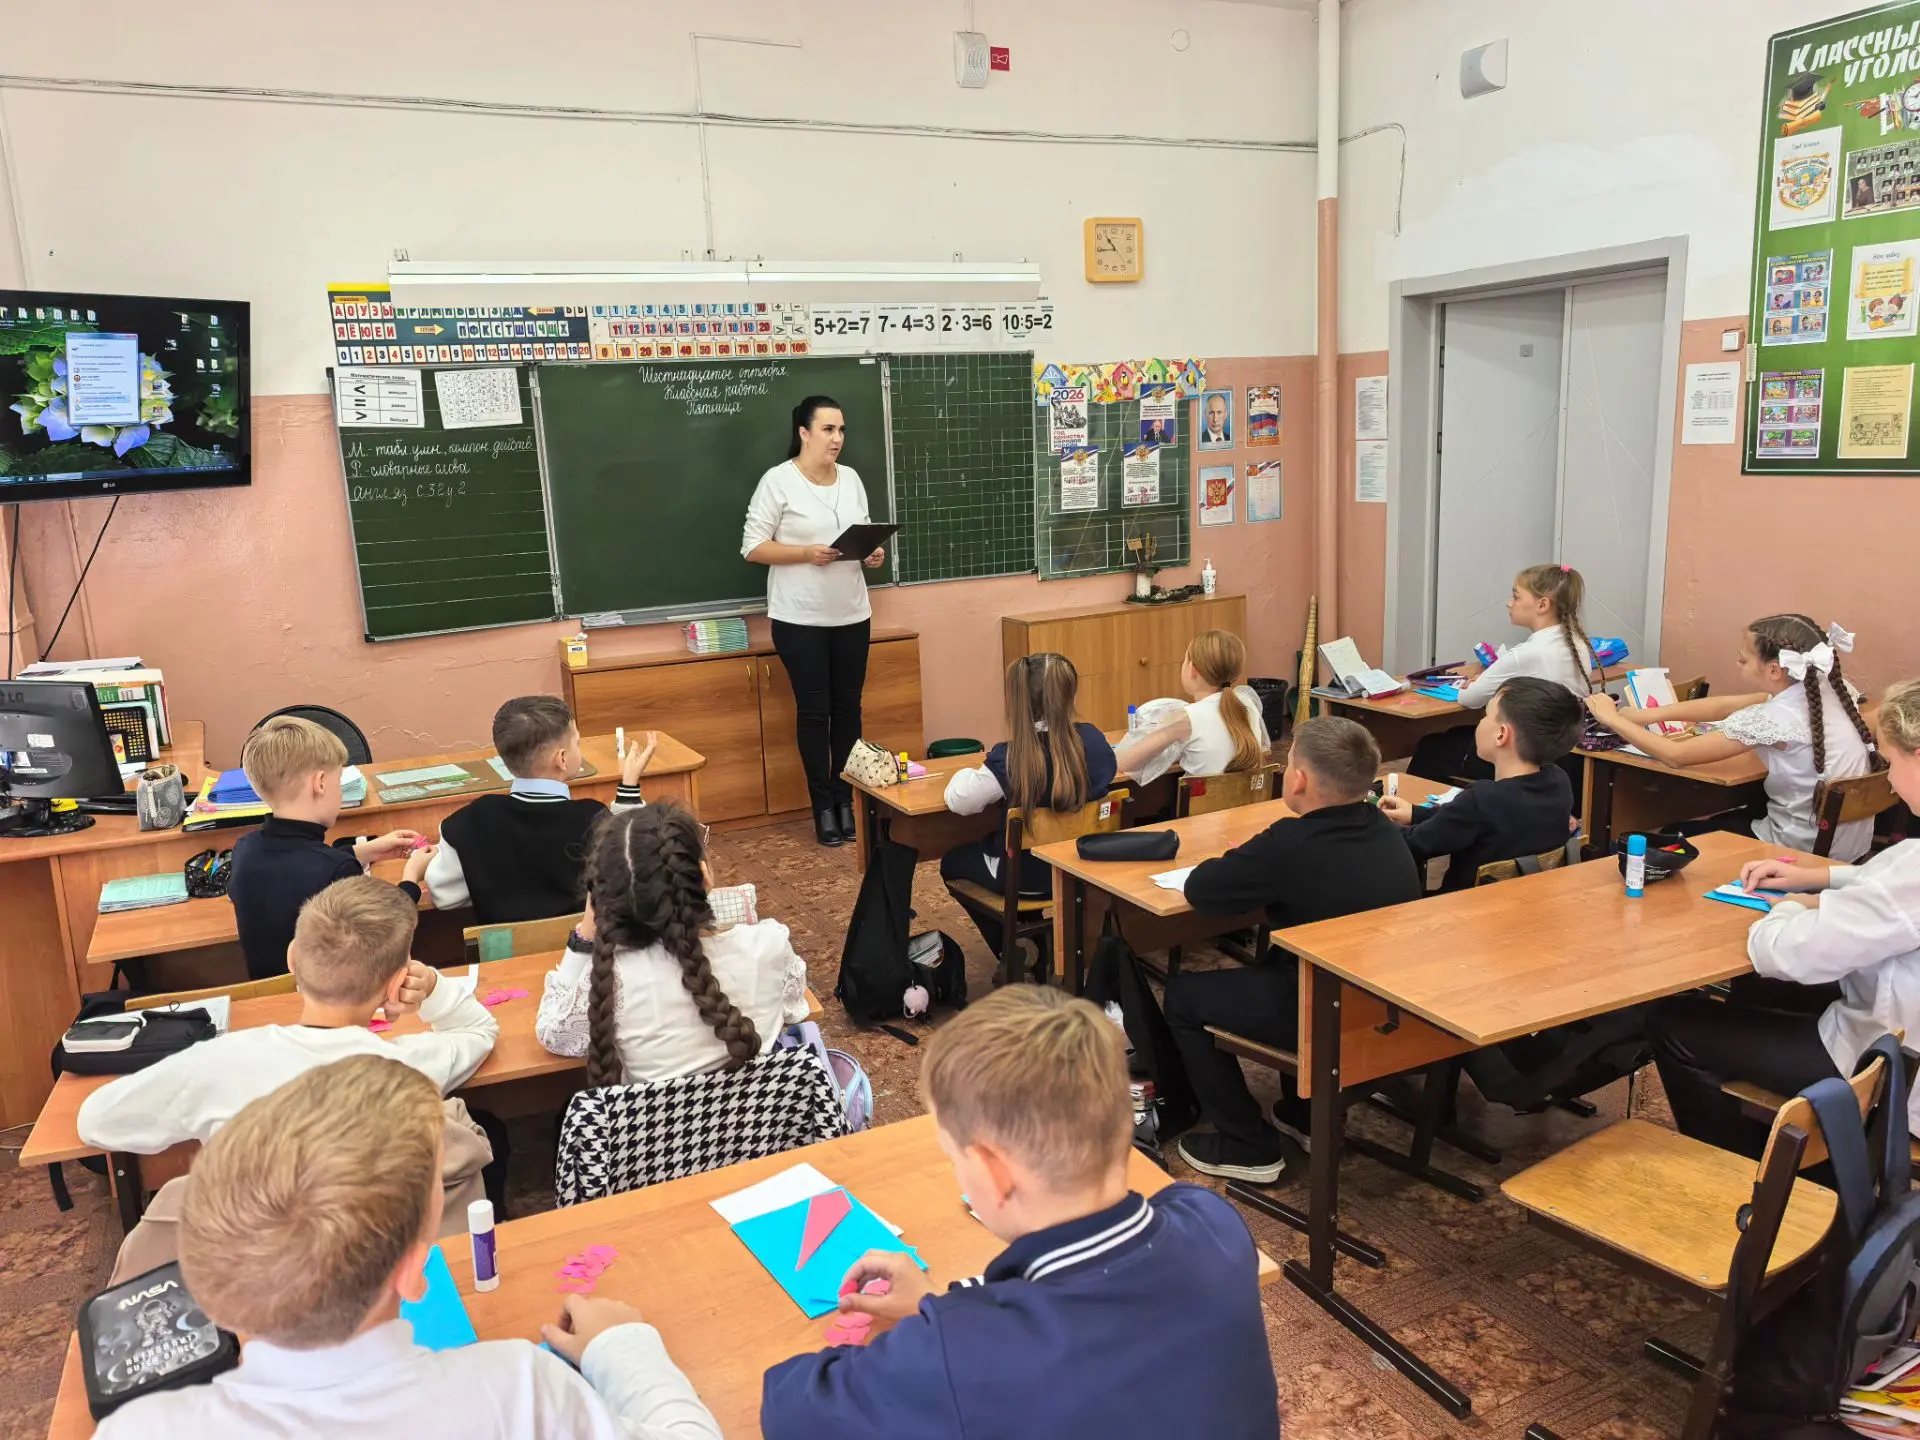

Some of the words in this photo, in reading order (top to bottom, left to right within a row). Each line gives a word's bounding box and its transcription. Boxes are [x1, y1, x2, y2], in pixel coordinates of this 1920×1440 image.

[1788, 20, 1920, 76] КЛАССНЫ
[1053, 389, 1085, 400] 2026
[8, 692, 24, 703] LG
[117, 1280, 179, 1310] NASA
